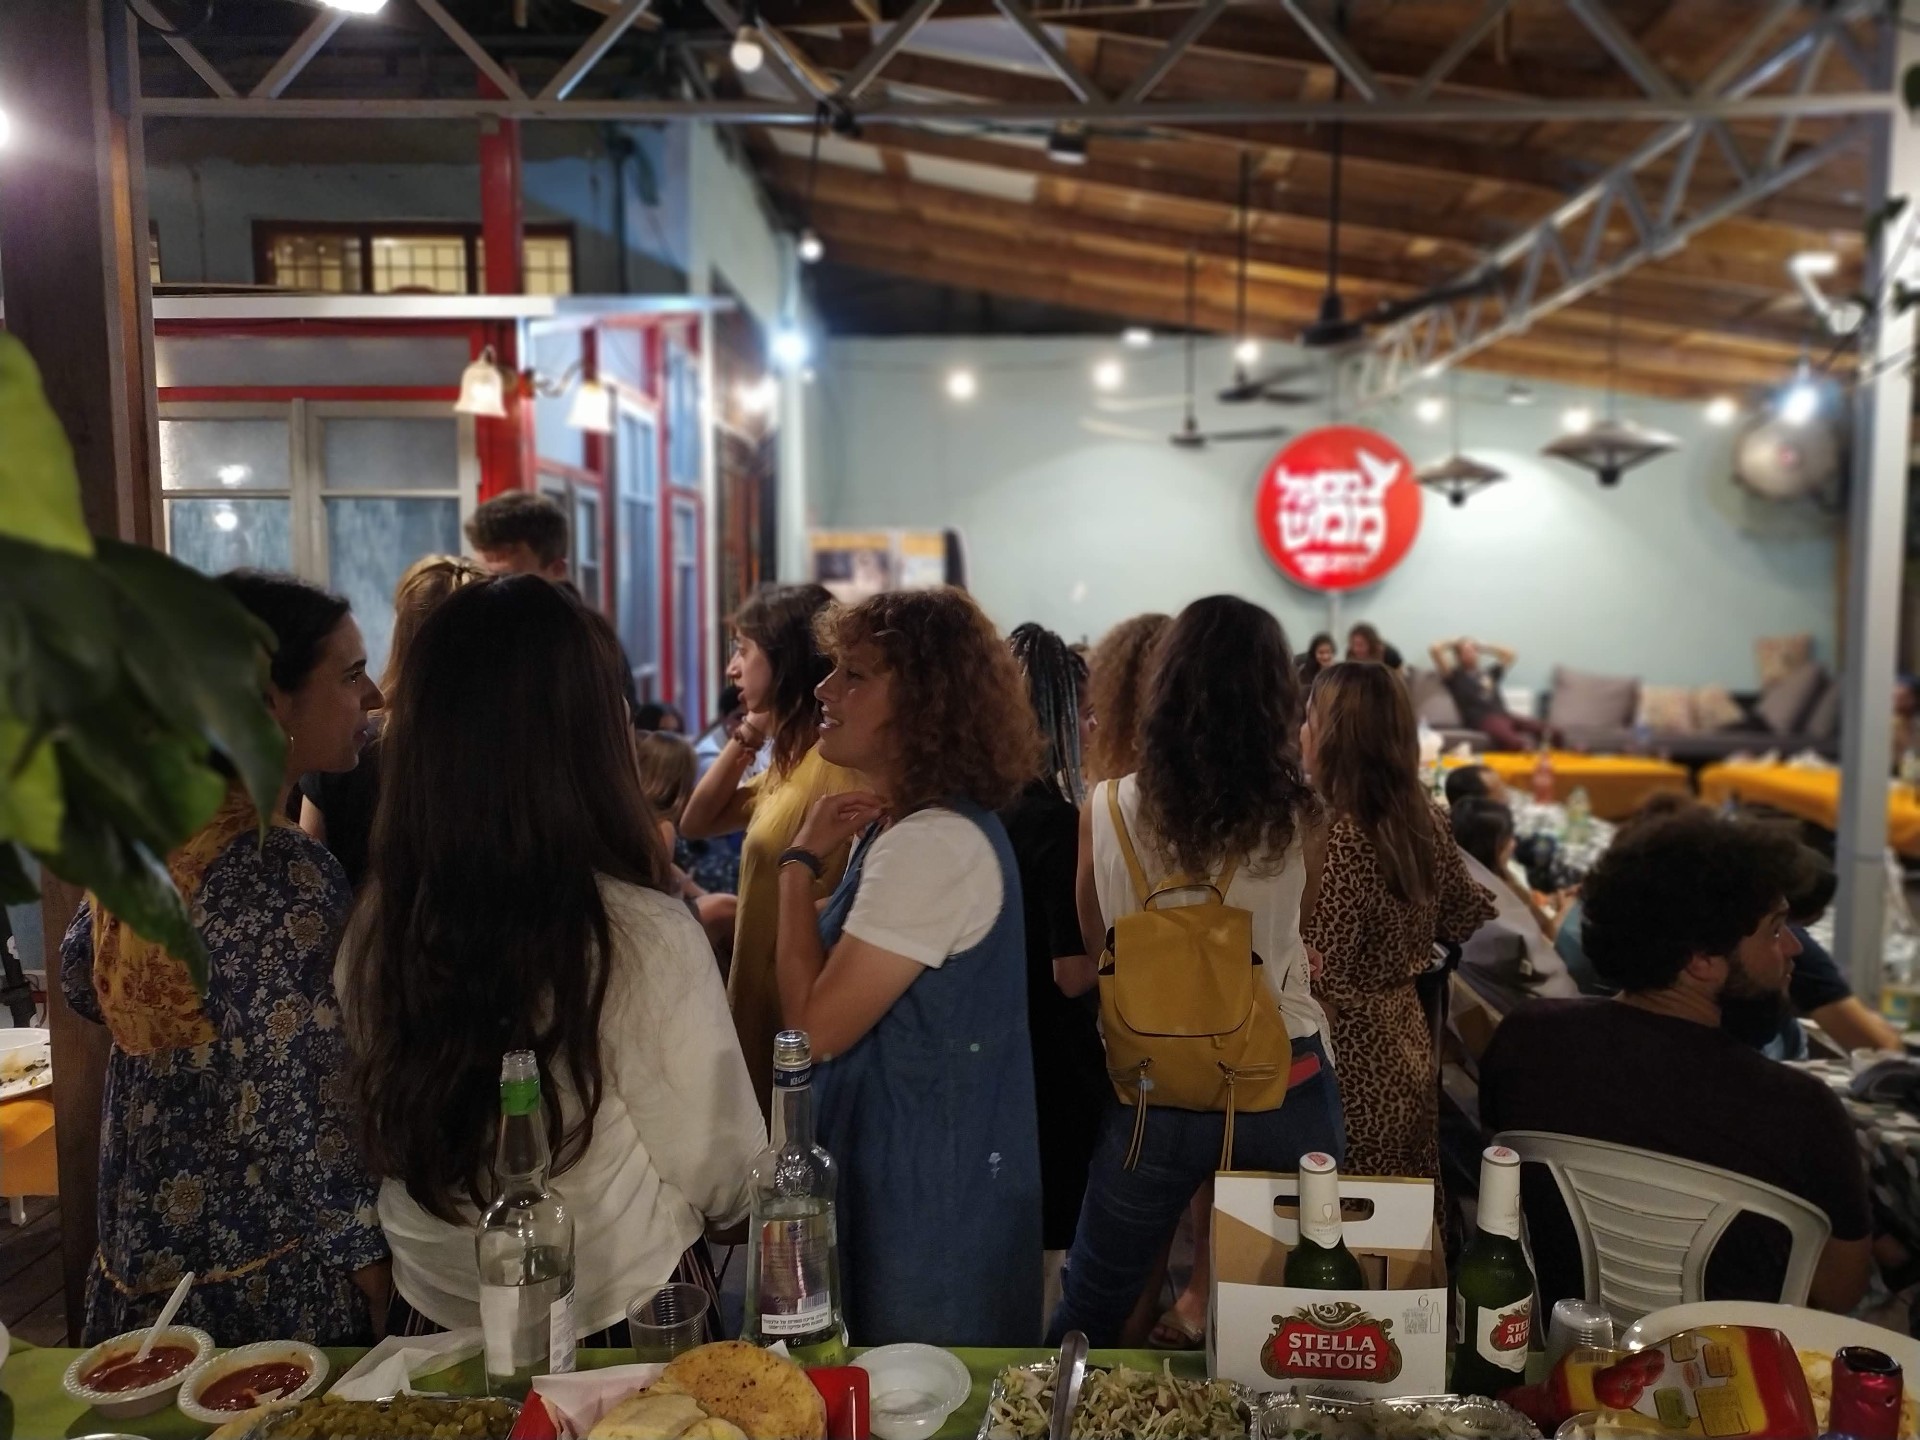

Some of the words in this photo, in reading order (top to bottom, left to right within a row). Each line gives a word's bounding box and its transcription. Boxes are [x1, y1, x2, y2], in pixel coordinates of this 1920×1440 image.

[1507, 1318, 1530, 1333] STEL
[1288, 1332, 1376, 1351] STELLA
[1286, 1351, 1377, 1370] ARTOIS
